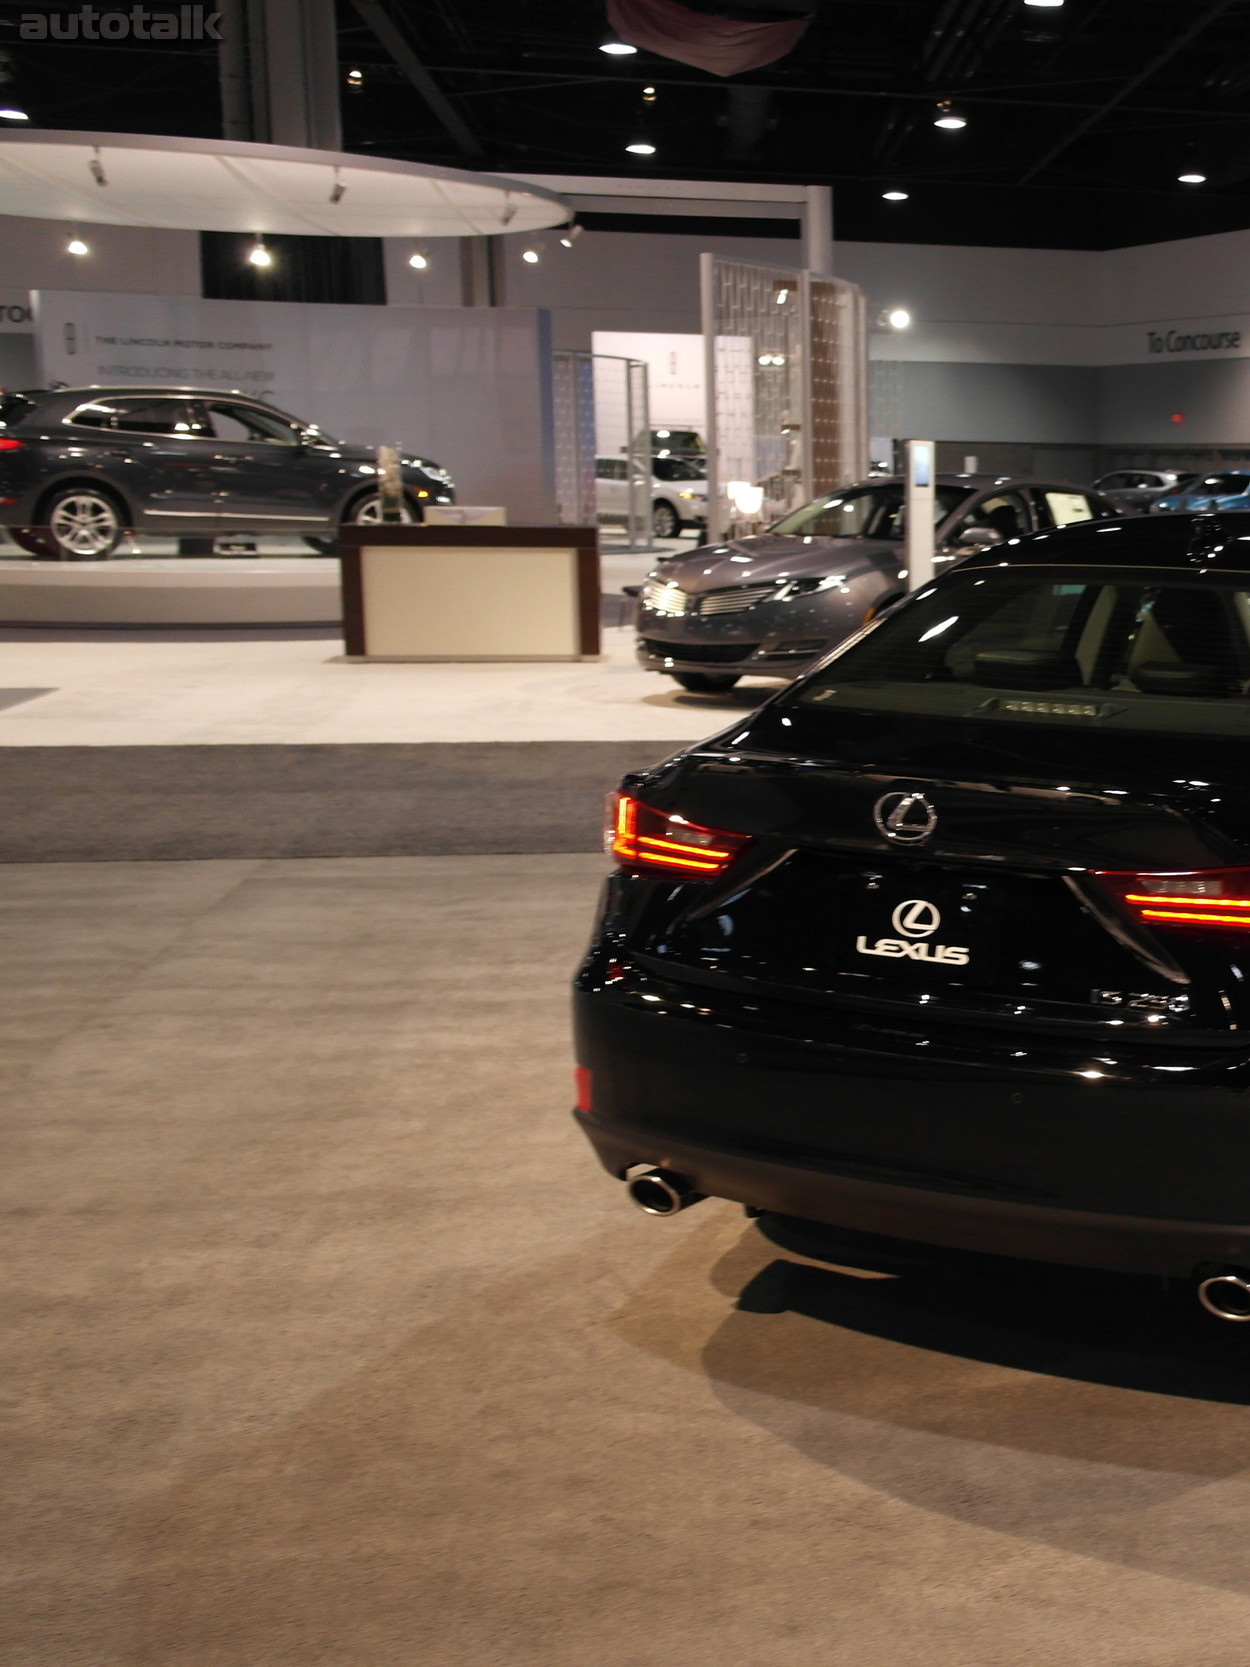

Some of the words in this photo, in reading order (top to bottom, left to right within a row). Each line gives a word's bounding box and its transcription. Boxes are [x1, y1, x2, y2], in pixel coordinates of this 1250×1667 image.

[121, 337, 170, 348] LINCOLN
[1147, 331, 1163, 352] To
[1166, 330, 1241, 352] Concourse
[856, 935, 970, 966] LEXUS
